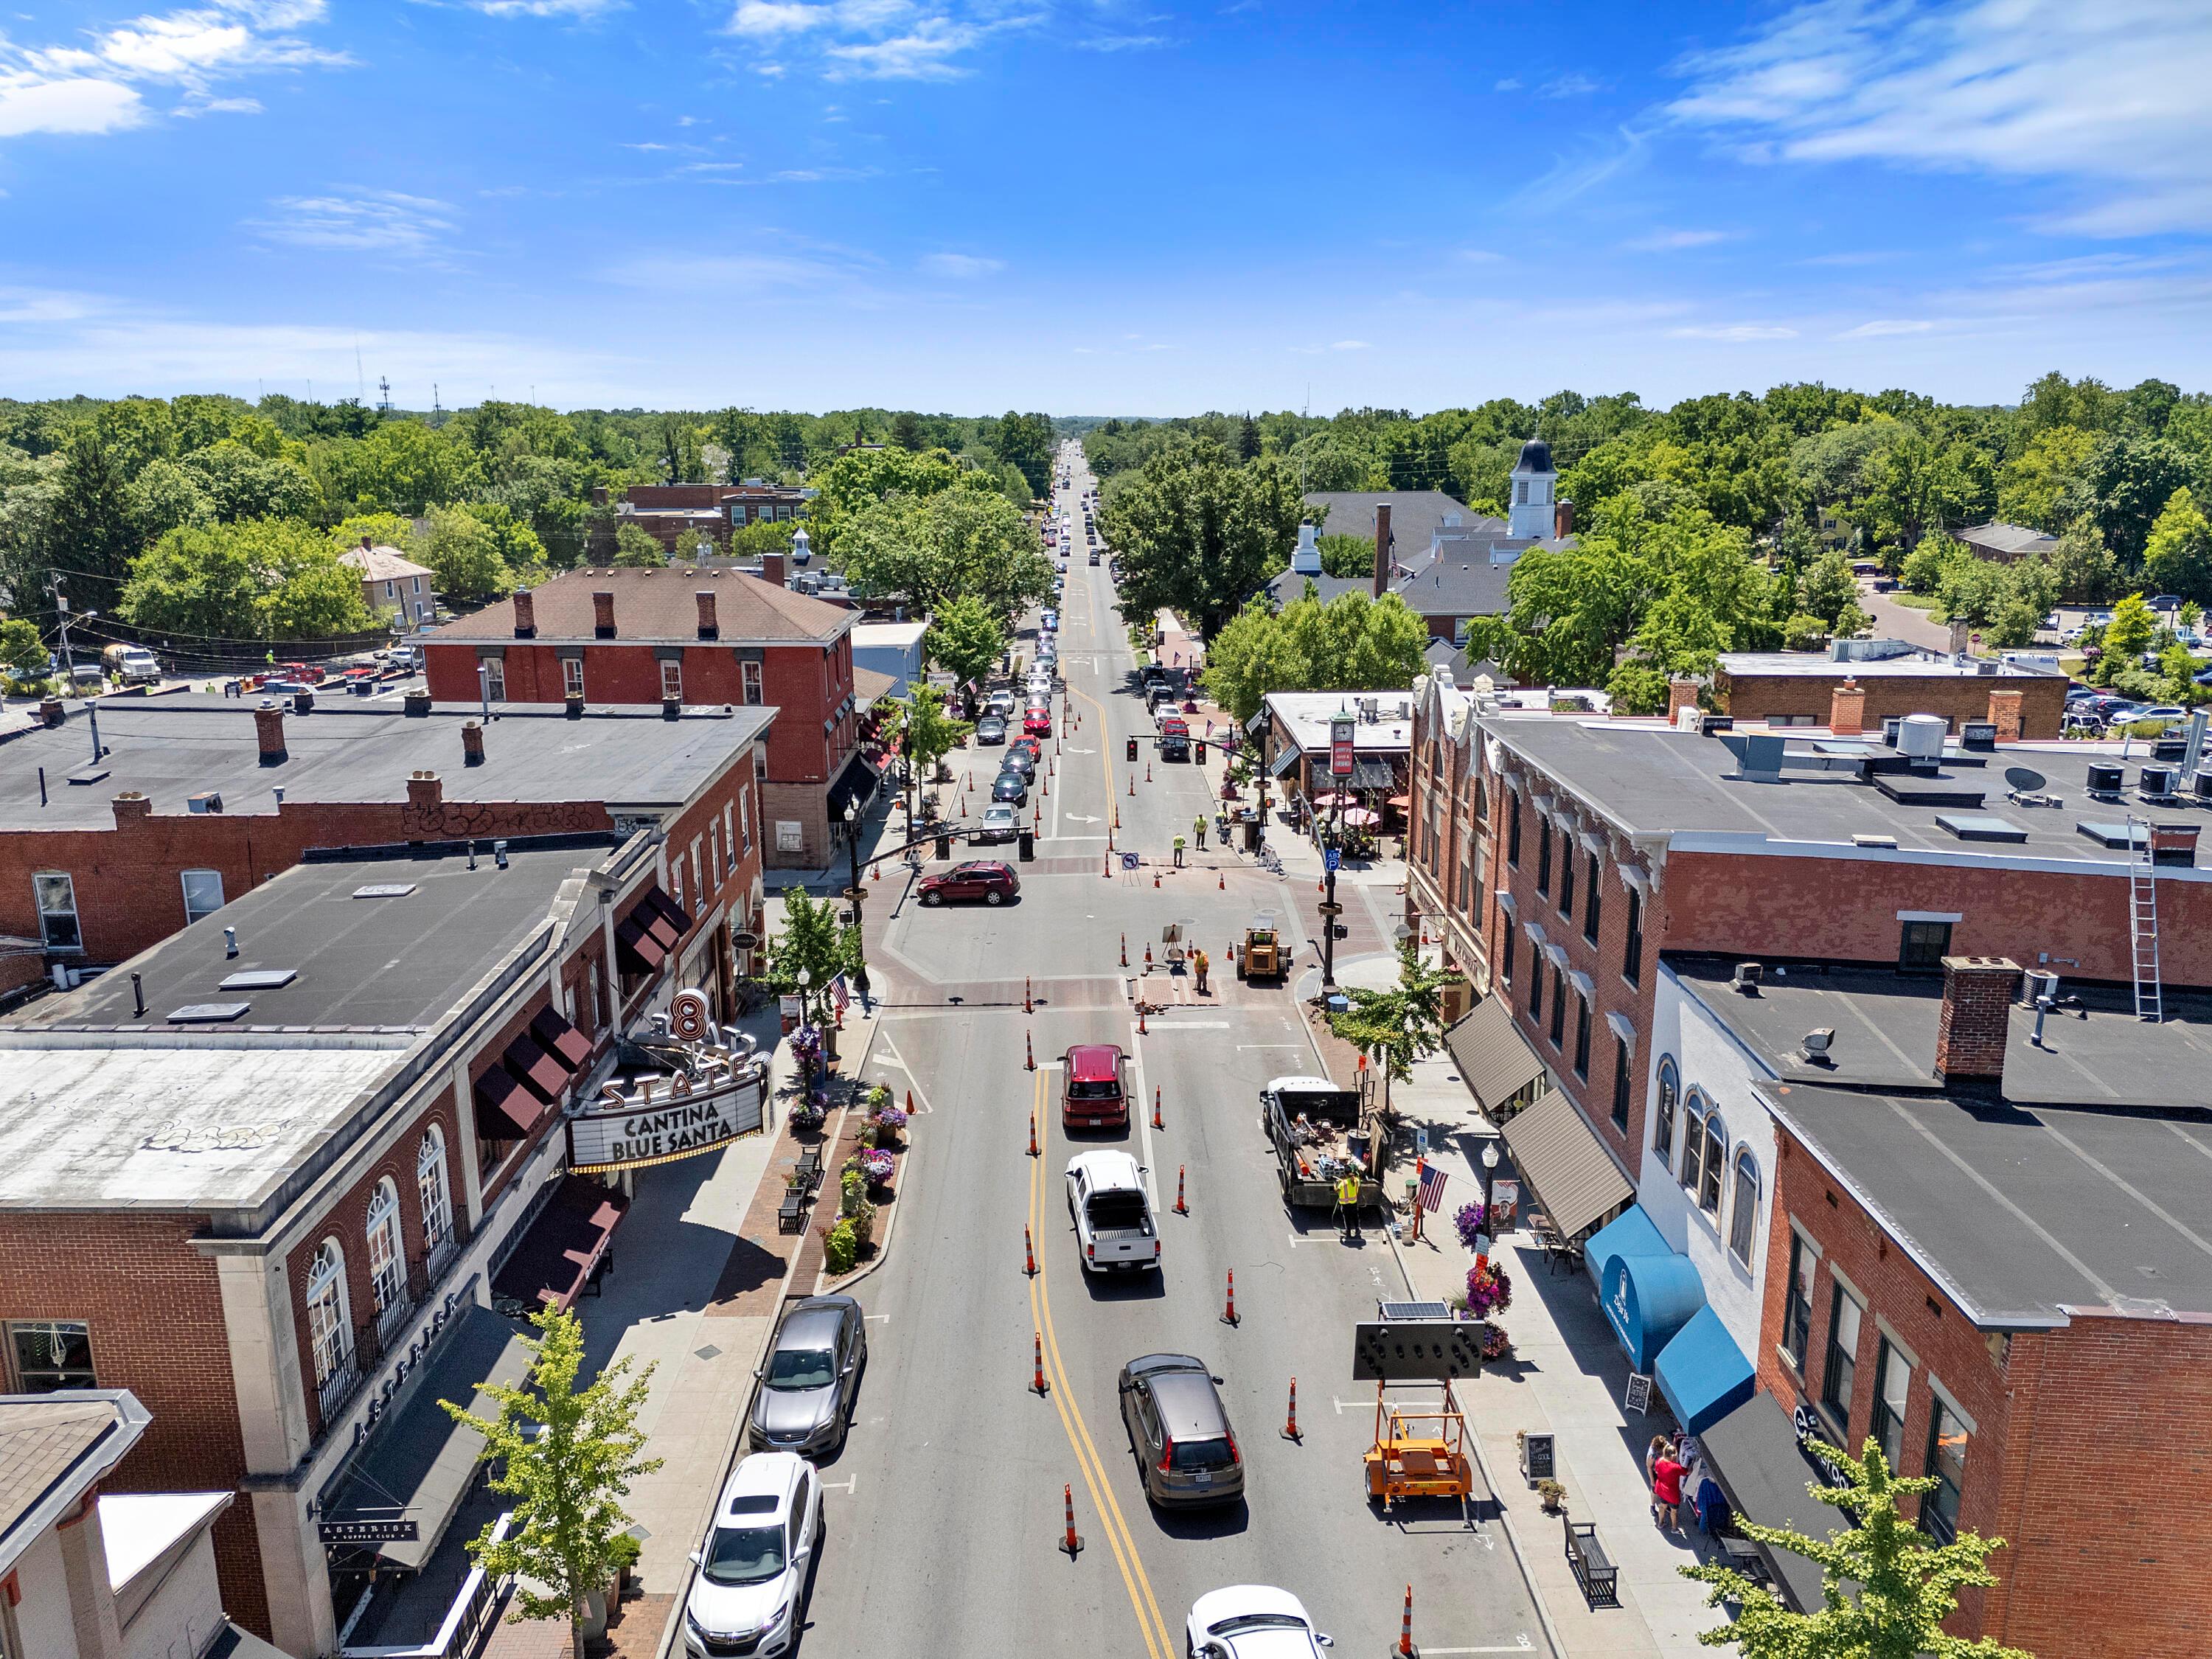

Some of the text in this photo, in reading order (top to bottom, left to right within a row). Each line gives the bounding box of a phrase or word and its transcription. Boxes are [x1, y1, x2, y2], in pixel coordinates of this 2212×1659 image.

[670, 993, 708, 1041] 8
[602, 1054, 748, 1109] STATE
[612, 1119, 732, 1161] BLUE SANTA
[625, 1102, 720, 1138] CANTINA
[358, 1294, 458, 1445] ASTERISK
[324, 1525, 412, 1534] ASTERISK
